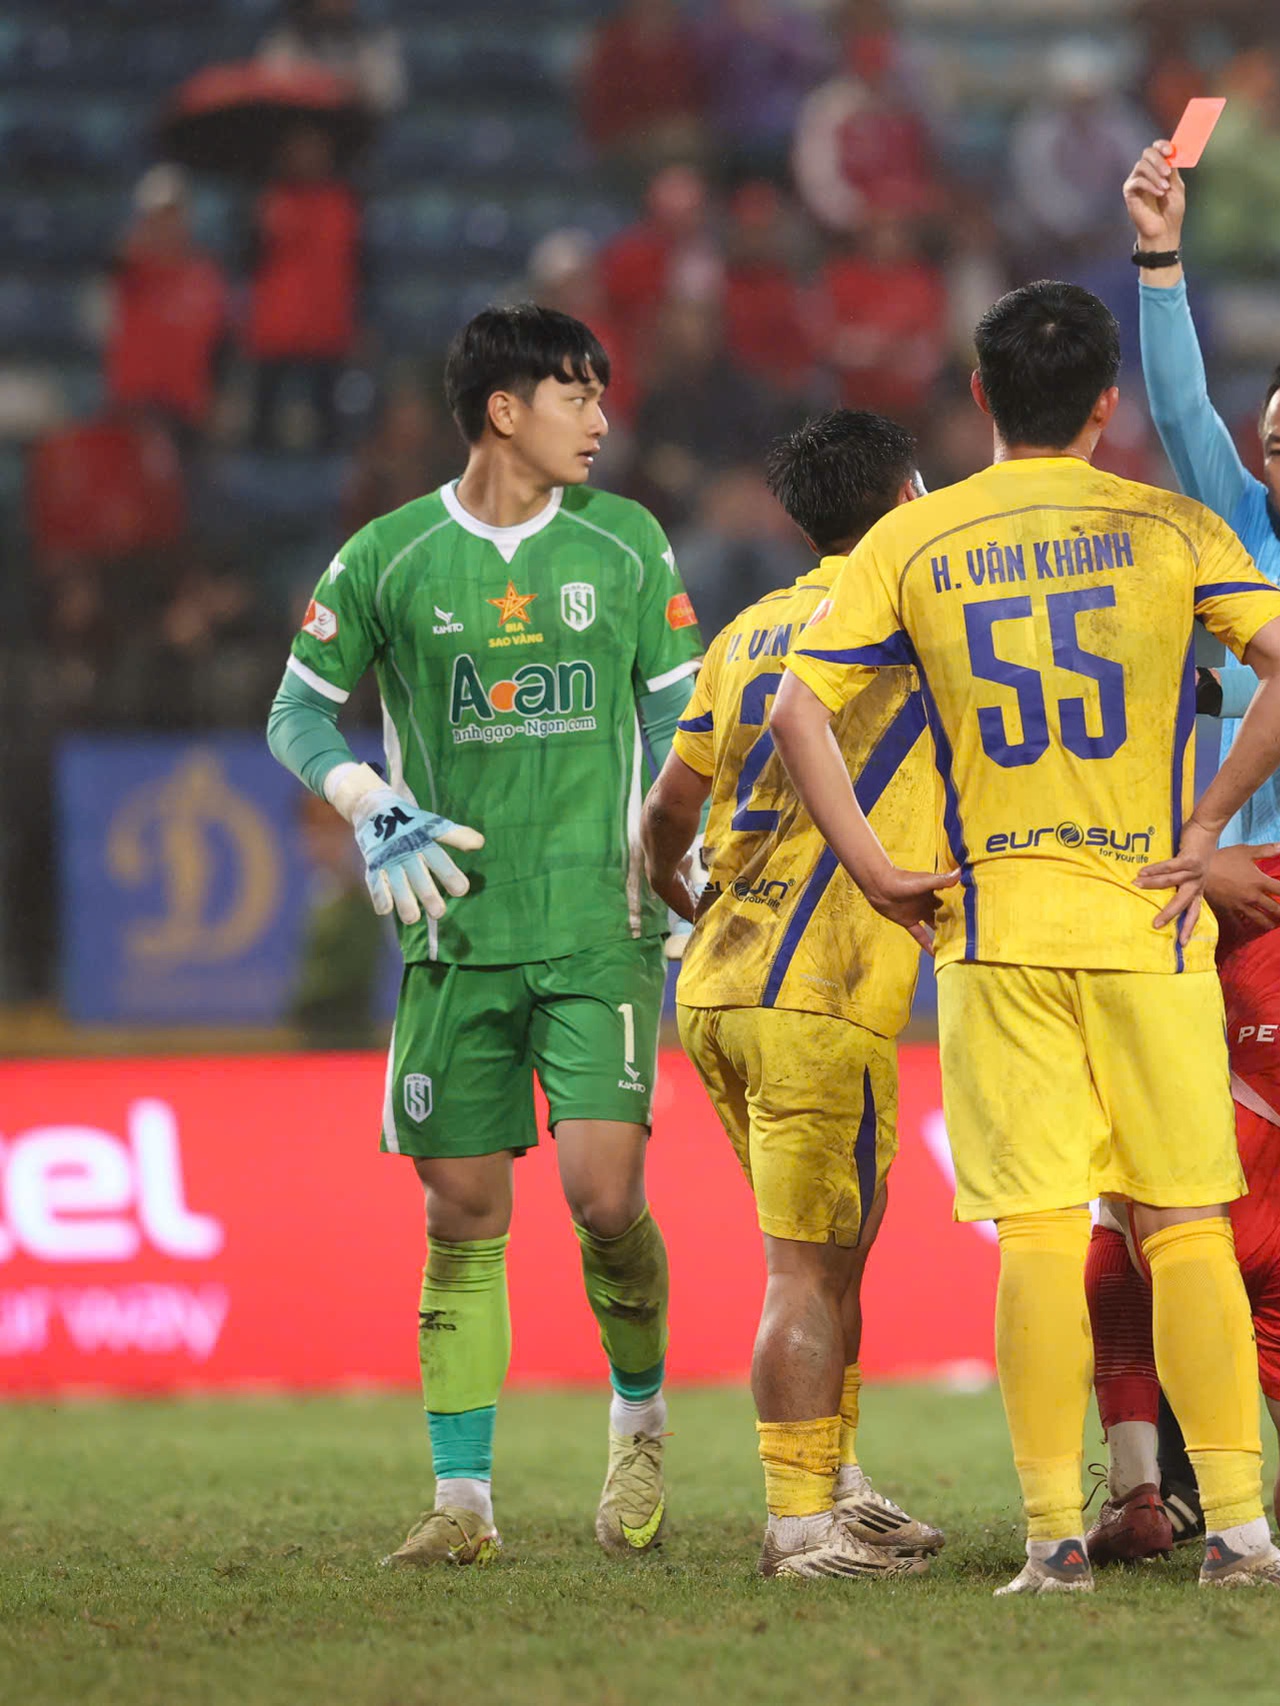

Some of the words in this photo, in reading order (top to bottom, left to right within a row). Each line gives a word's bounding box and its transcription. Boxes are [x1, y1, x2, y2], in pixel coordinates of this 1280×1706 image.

[931, 555, 961, 593] H.
[966, 541, 1026, 586] VĂN
[1033, 531, 1134, 579] KHÁNH
[505, 623, 525, 633] BIA
[488, 636, 512, 648] SAO
[511, 633, 544, 646] VÀNG
[963, 585, 1127, 768] 55
[526, 719, 566, 738] Ngon
[1099, 848, 1112, 857] for
[1114, 852, 1134, 863] your
[618, 1003, 635, 1063] 1
